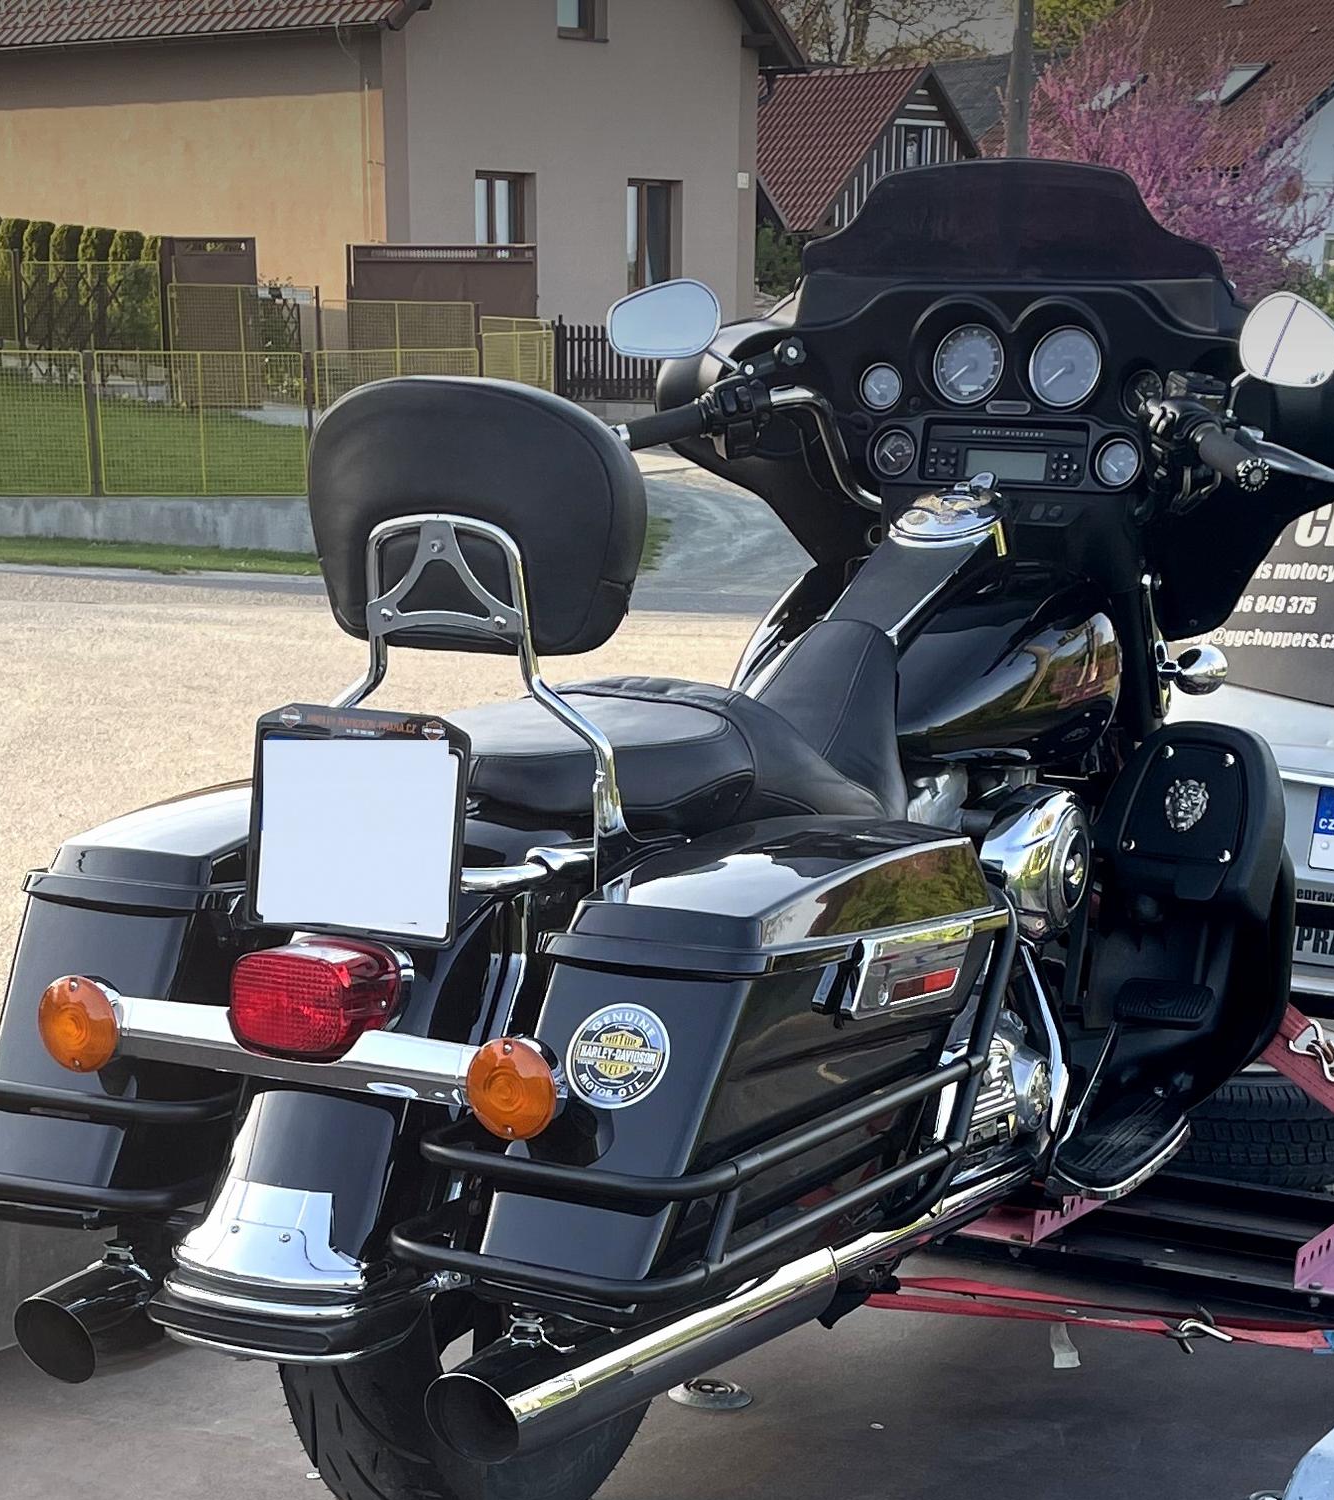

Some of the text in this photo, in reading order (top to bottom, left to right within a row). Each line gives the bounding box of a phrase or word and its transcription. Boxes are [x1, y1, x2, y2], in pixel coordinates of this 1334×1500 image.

[1254, 595, 1287, 614] 849
[1286, 597, 1318, 615] 375
[592, 1012, 656, 1038] GENUINE
[579, 1045, 657, 1065] HARLEY-DAVIDSON
[578, 1072, 645, 1098] MOTOR OIL
